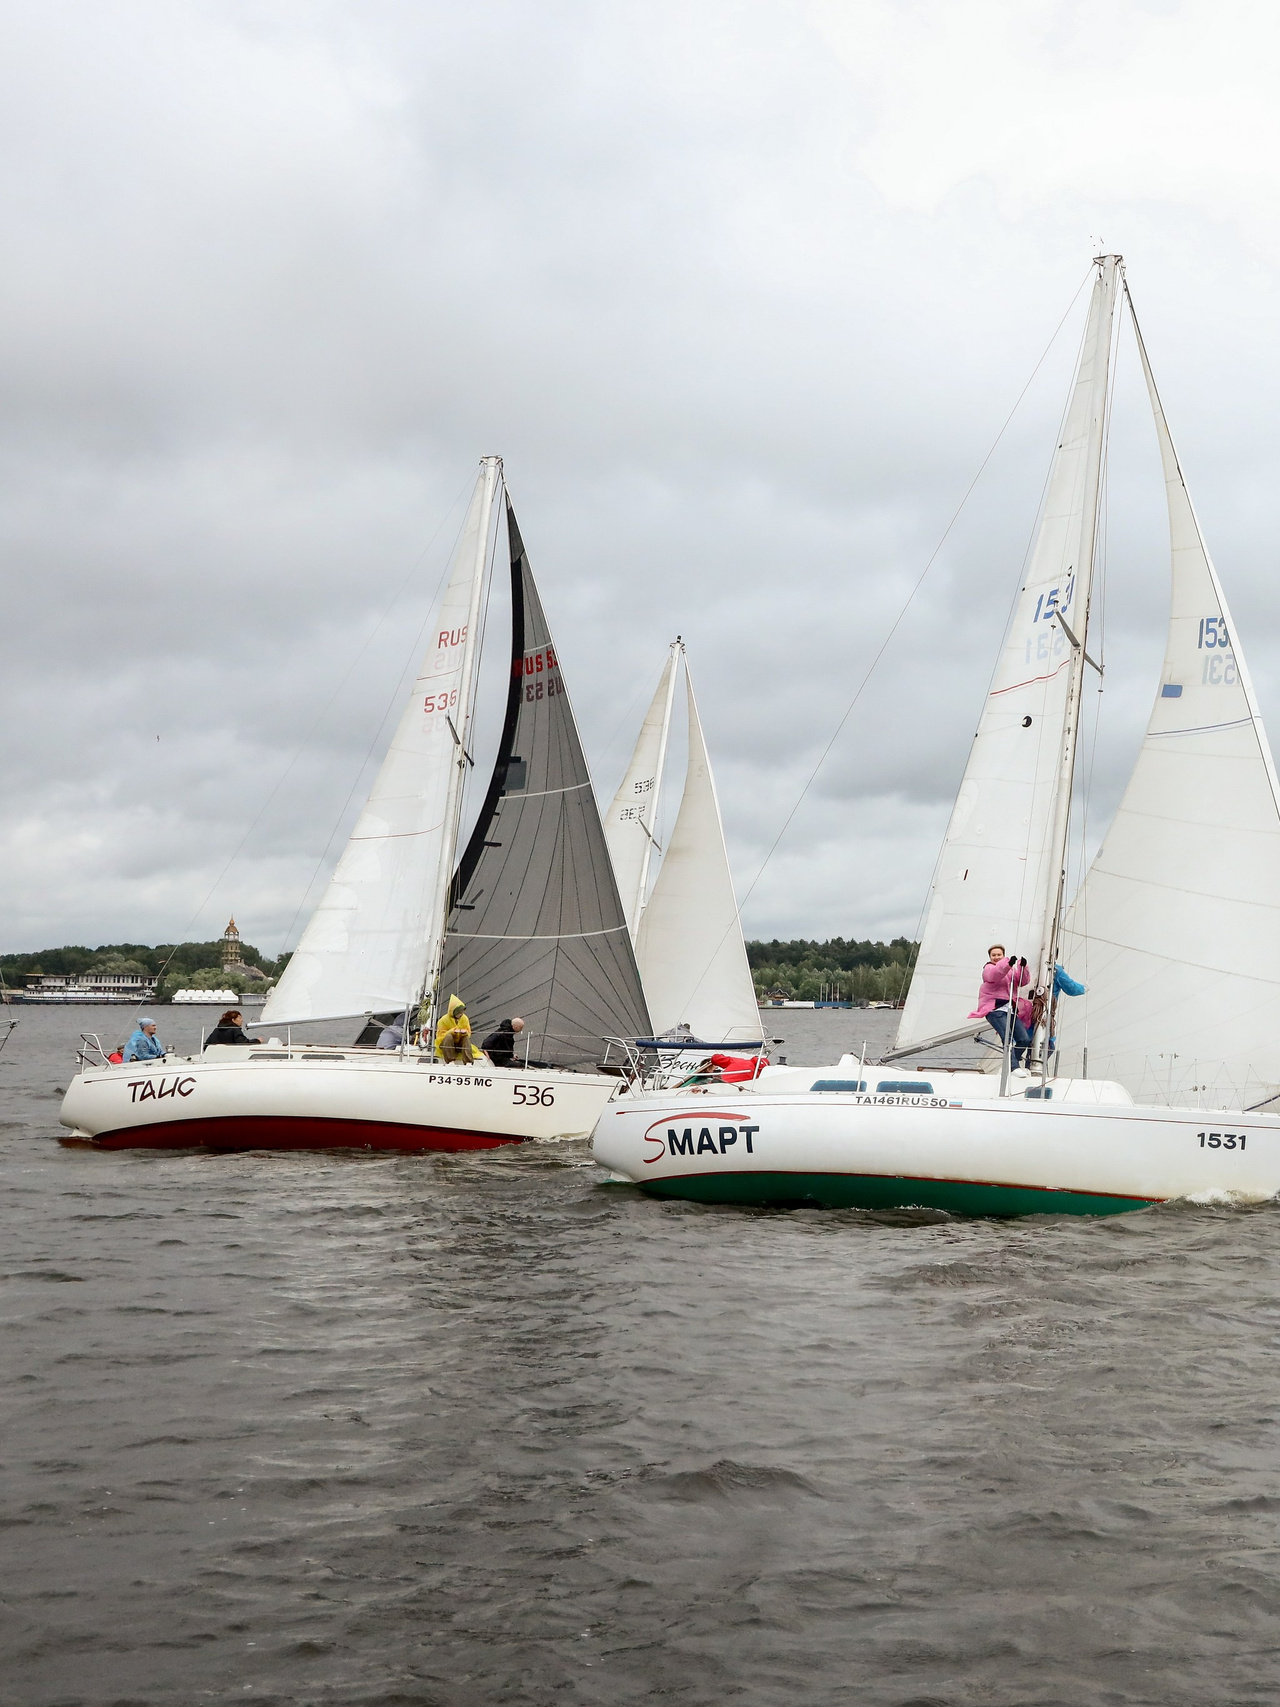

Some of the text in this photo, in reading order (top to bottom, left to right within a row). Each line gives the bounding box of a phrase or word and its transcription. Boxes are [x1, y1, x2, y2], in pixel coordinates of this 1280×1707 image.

[438, 625, 468, 649] RUS
[1198, 617, 1231, 649] 153
[512, 1085, 555, 1107] 536
[1197, 1132, 1246, 1150] 1531
